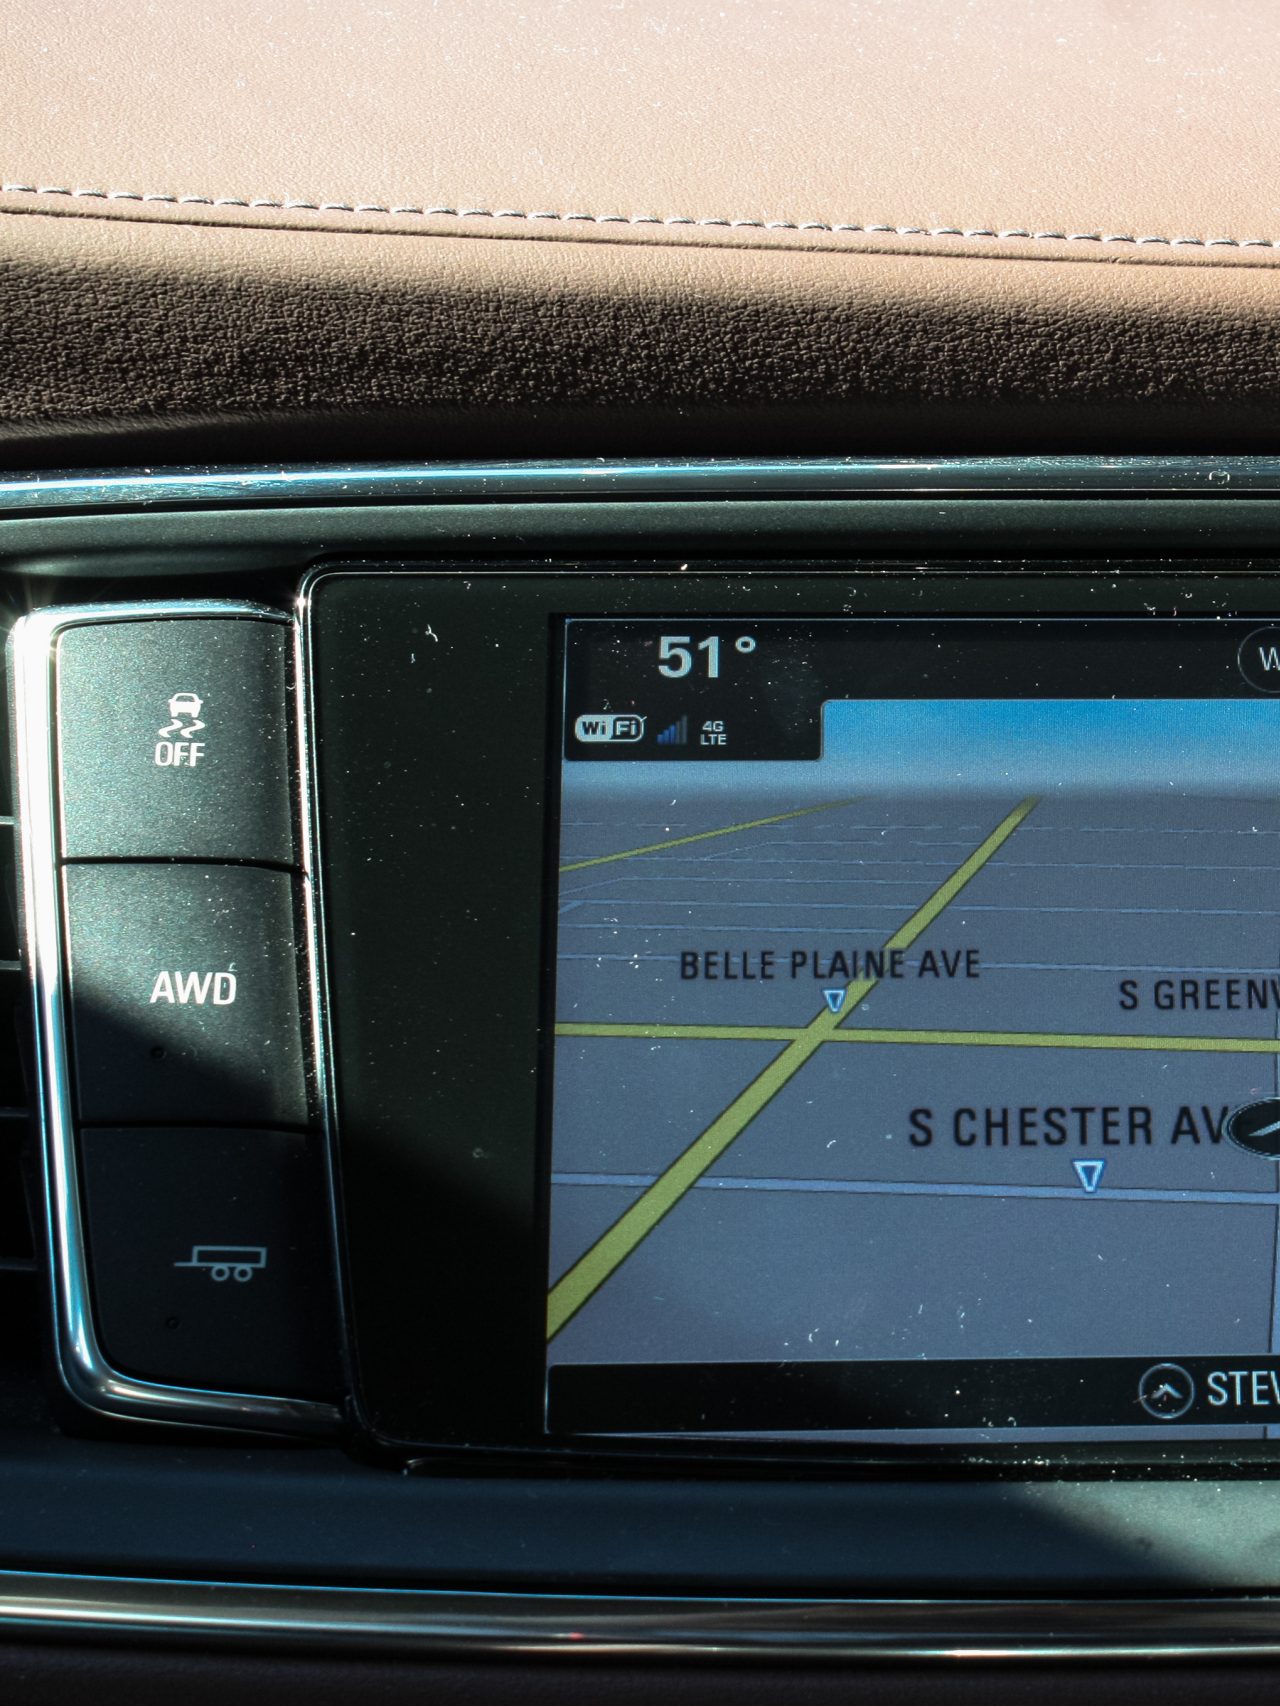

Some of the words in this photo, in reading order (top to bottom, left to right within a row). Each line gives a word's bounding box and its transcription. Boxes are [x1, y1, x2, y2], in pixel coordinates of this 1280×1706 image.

[700, 734, 727, 746] LTE
[702, 720, 724, 732] 4G
[155, 742, 206, 767] OFF
[680, 951, 776, 979] BELLE
[790, 951, 905, 979] PLAINE
[919, 949, 981, 978] AVE
[150, 972, 237, 1005] AWD
[1119, 981, 1139, 1010] S
[909, 1108, 933, 1147] S
[953, 1107, 1153, 1146] CHESTER
[1170, 1106, 1230, 1145] AV
